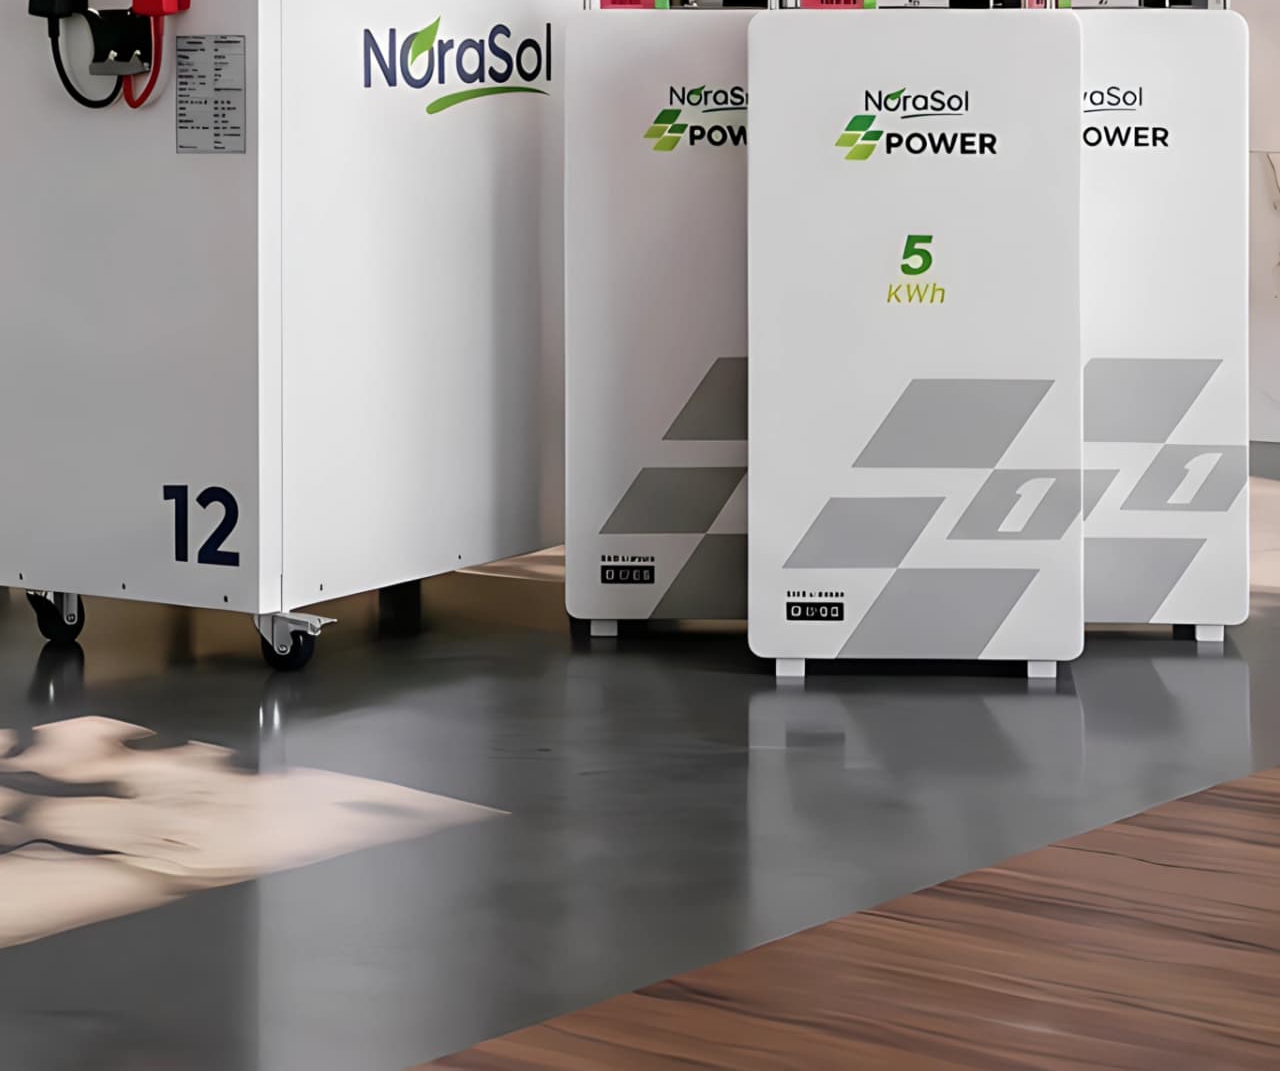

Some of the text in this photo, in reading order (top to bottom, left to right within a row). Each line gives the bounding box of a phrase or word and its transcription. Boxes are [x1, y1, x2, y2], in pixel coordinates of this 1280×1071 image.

[363, 16, 552, 89] NoraSol
[670, 85, 748, 107] NoraS
[865, 88, 969, 112] NoraSol
[886, 132, 997, 155] POWER
[900, 234, 933, 276] 5
[1166, 452, 1223, 504] 1
[163, 485, 240, 567] 12
[997, 478, 1057, 532] 1
